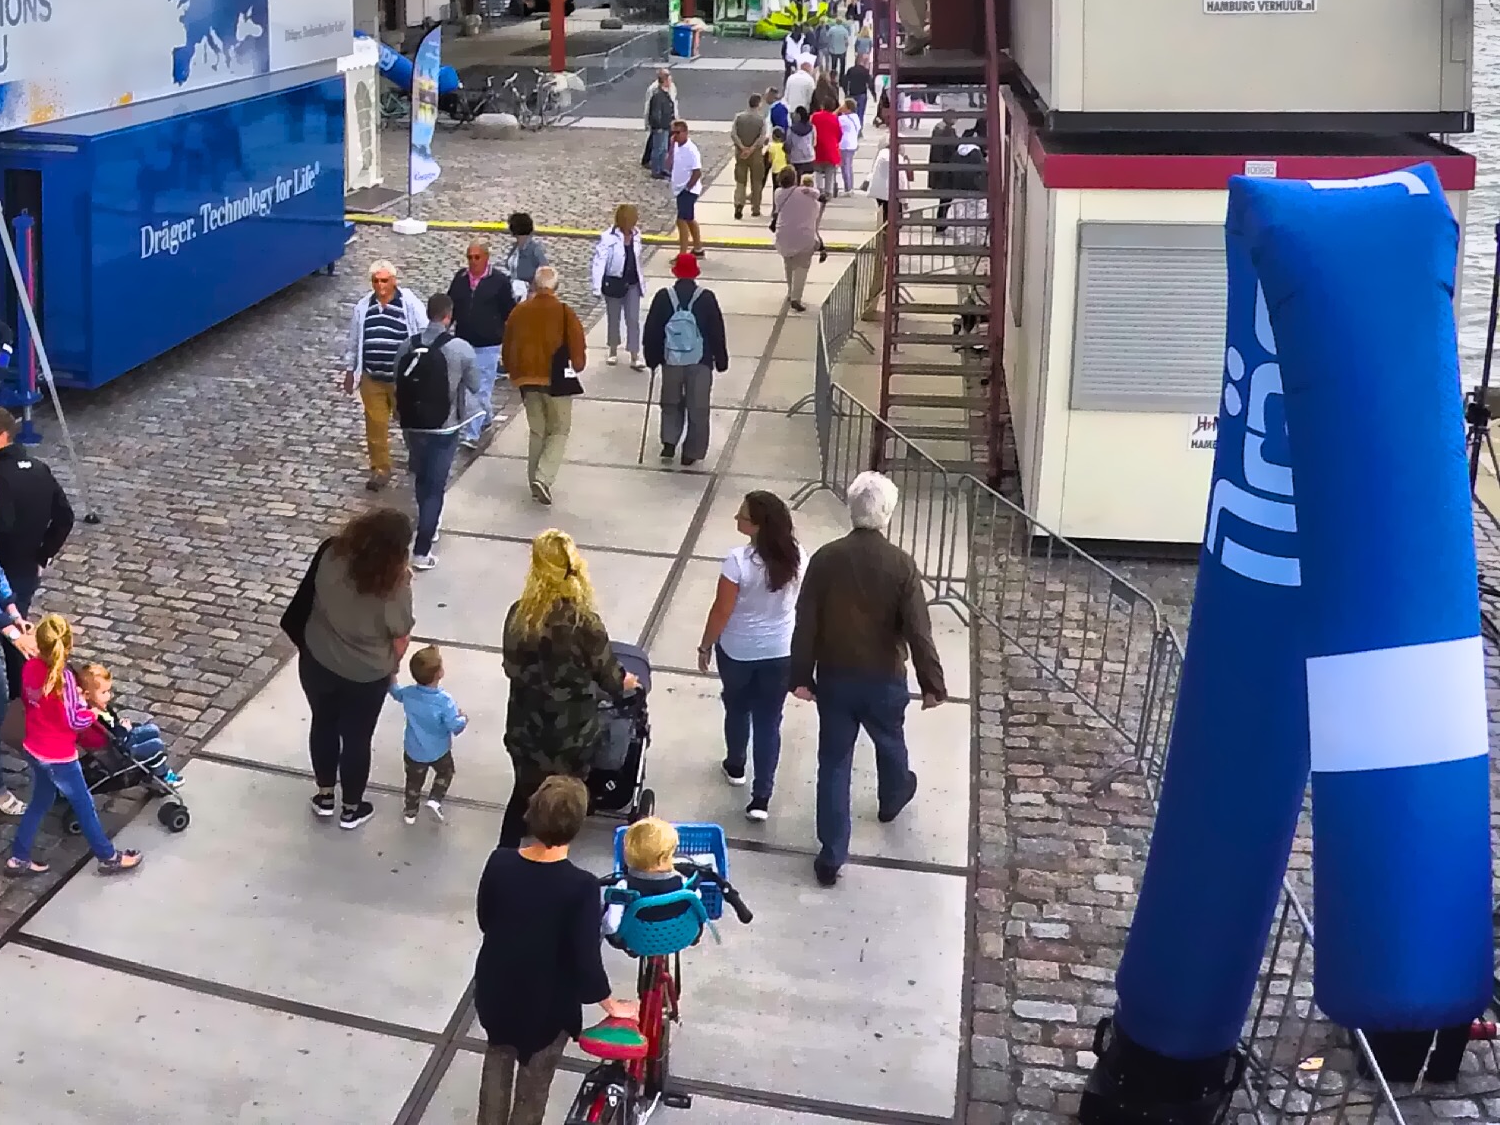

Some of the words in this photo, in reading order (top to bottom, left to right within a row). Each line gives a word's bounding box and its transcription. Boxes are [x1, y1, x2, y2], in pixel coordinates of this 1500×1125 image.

[1207, 1, 1255, 12] HAMBURG
[140, 217, 197, 259] Dräger.
[200, 187, 273, 235] Technology
[274, 175, 293, 204] for
